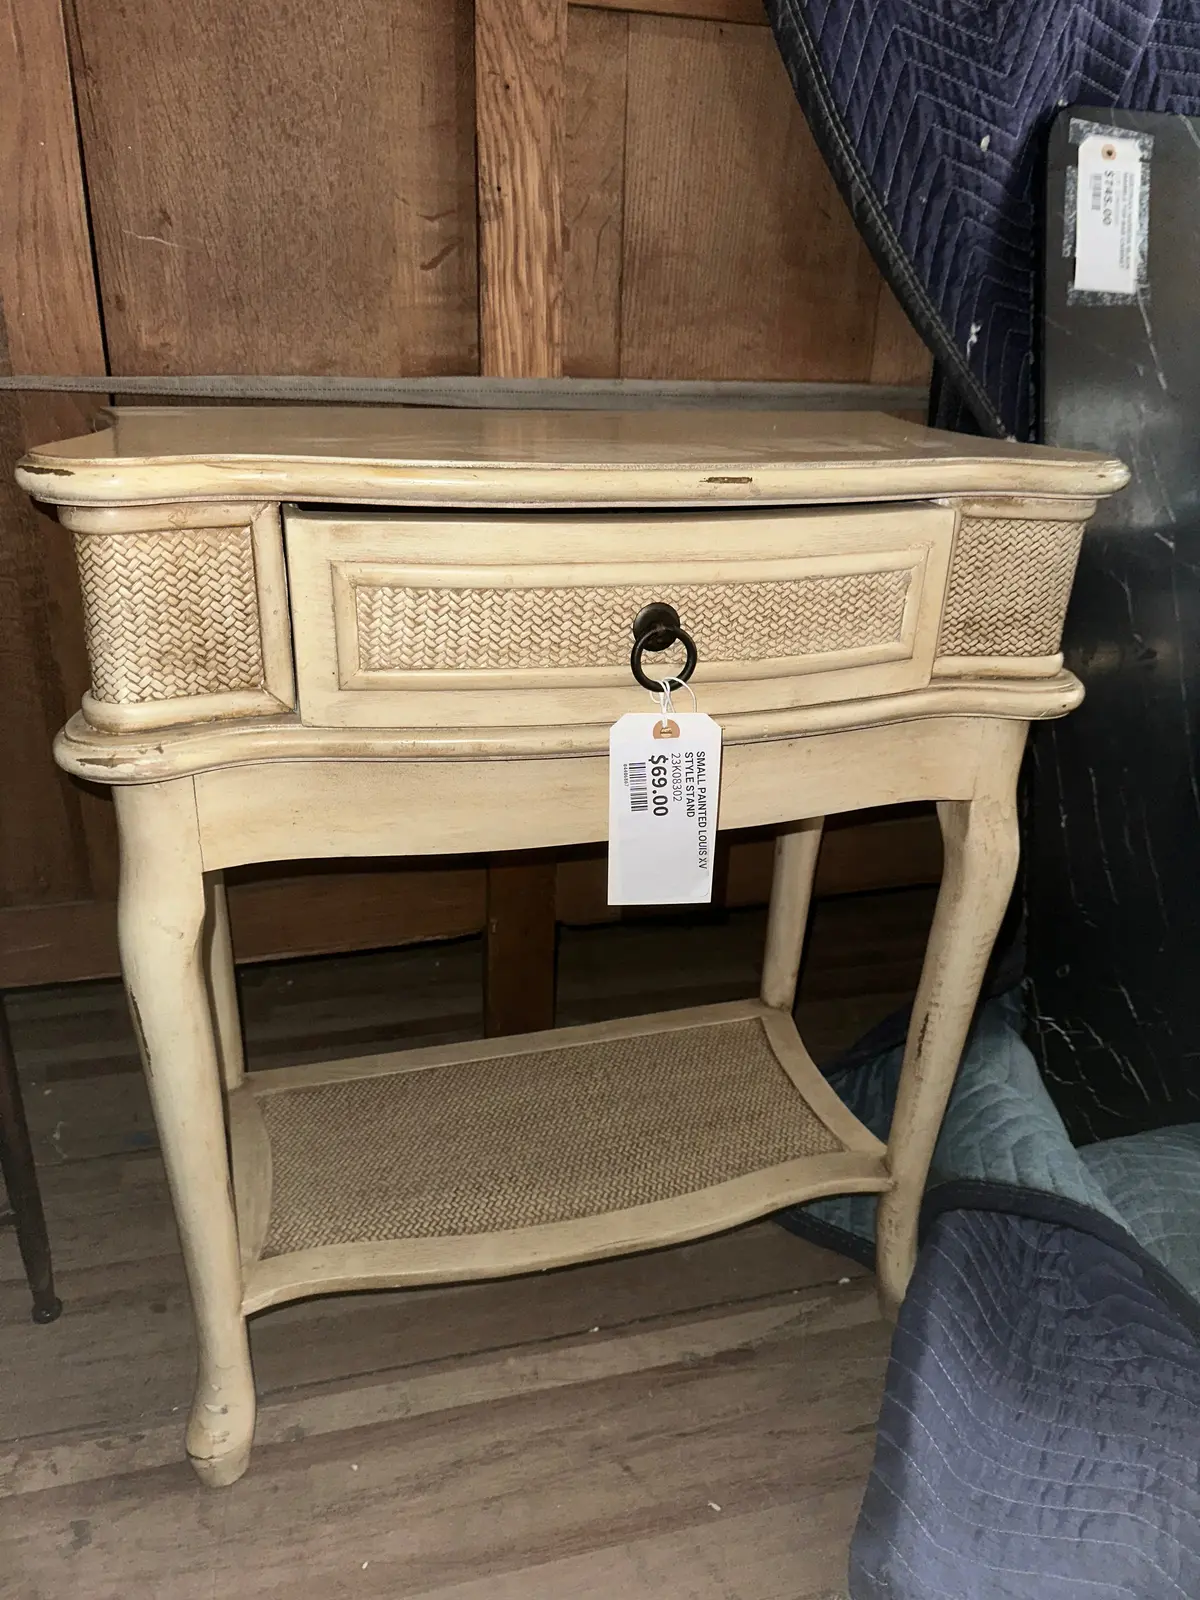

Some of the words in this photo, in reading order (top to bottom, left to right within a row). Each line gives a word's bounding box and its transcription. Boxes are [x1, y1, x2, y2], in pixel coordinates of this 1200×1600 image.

[671, 753, 683, 802] 23K08302
[684, 751, 695, 783] STYLE
[696, 751, 706, 786] SMALL
[648, 754, 669, 817] $69.00
[685, 785, 696, 818] STAND
[697, 787, 707, 828] PAINTED
[698, 829, 708, 856] LOUIS
[698, 857, 708, 870] XV
